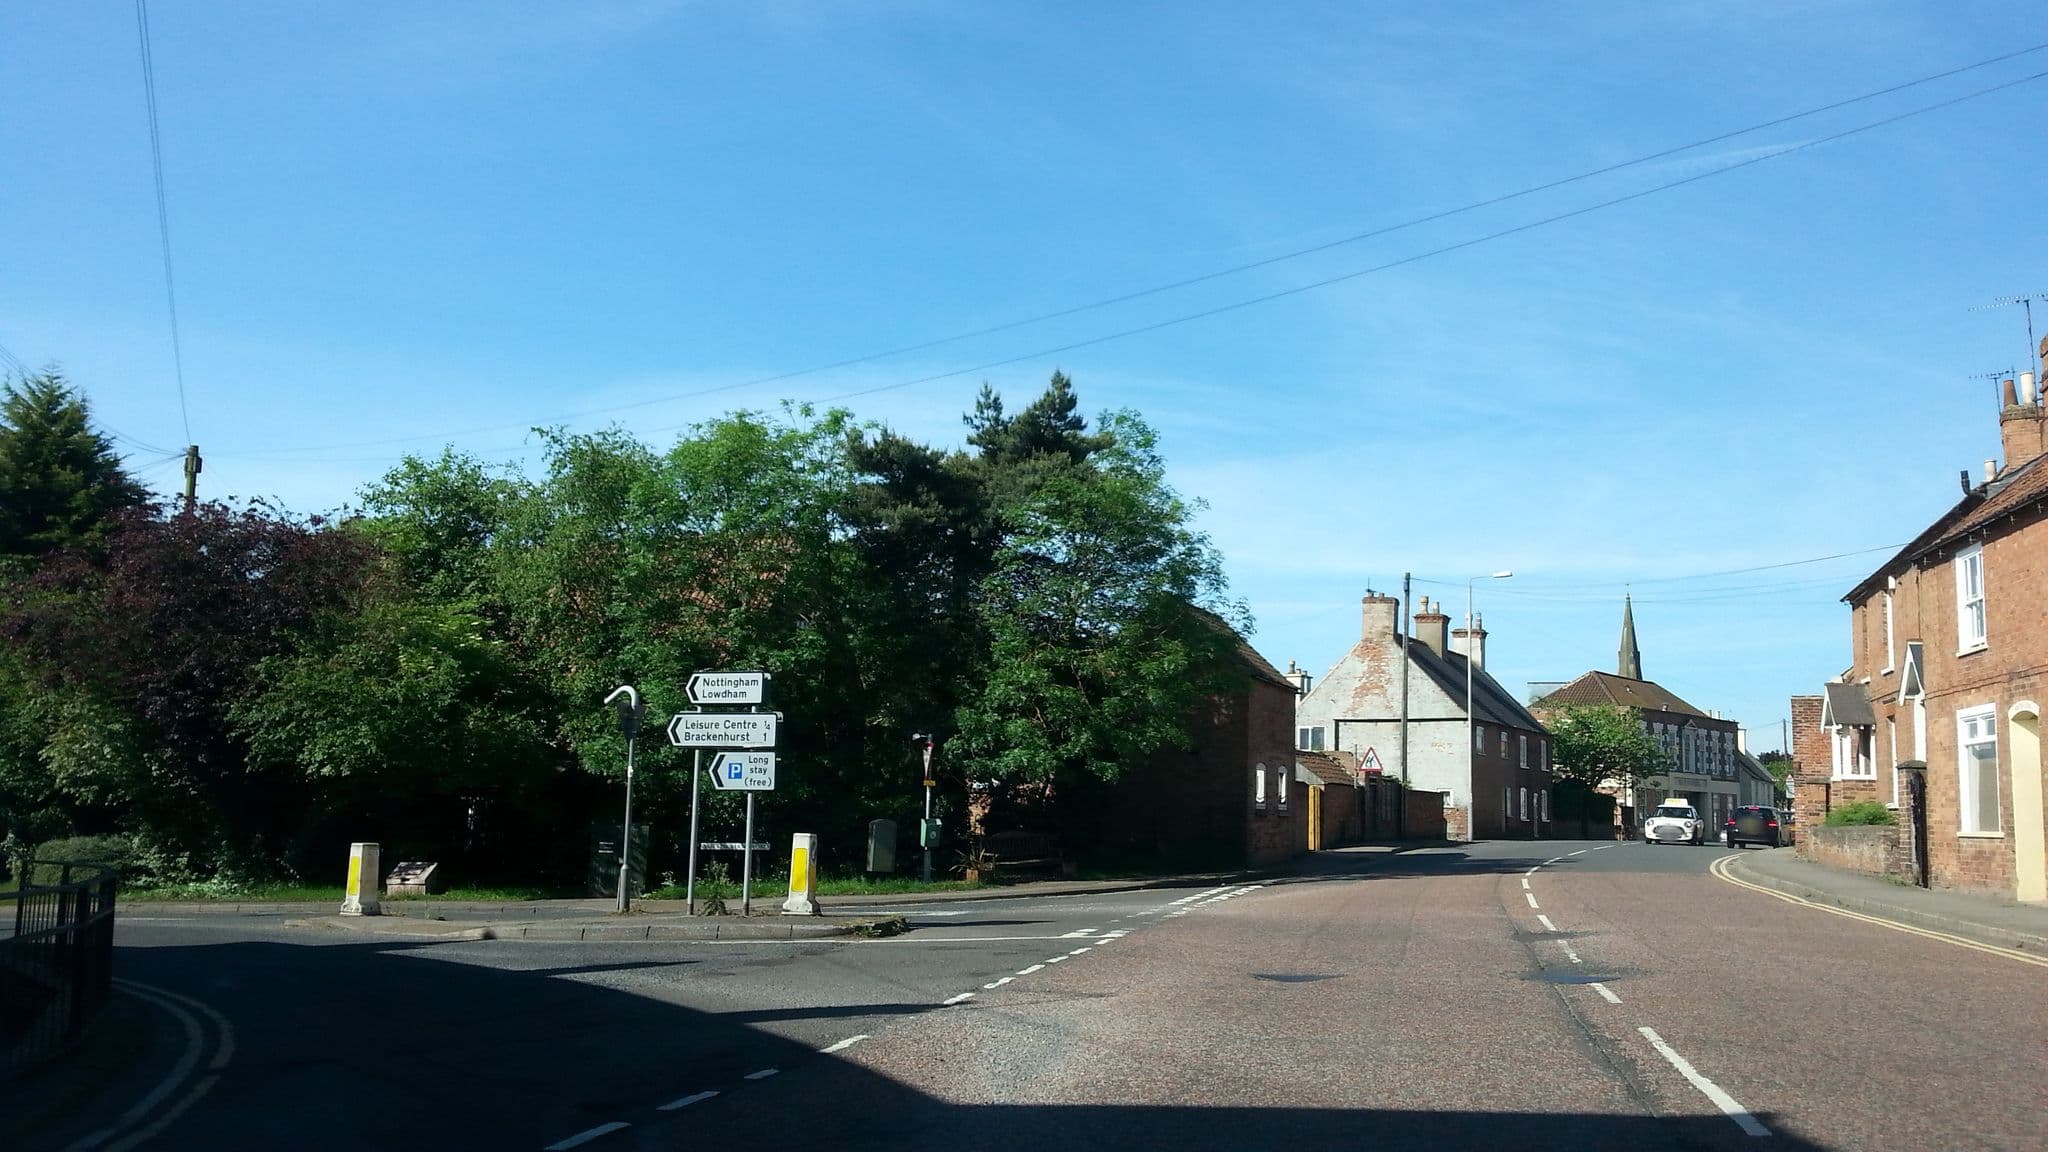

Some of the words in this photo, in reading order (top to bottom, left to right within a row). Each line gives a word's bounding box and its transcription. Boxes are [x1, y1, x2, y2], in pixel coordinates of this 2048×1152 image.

[703, 678, 759, 688] Nottingham
[702, 690, 747, 698] Lowdham
[685, 720, 720, 730] Leisure
[723, 720, 757, 729] Centre
[684, 732, 750, 742] Brackenhurst
[748, 756, 769, 765] Long
[730, 764, 741, 778] P
[749, 766, 768, 775] stay
[744, 777, 772, 787] (free)
